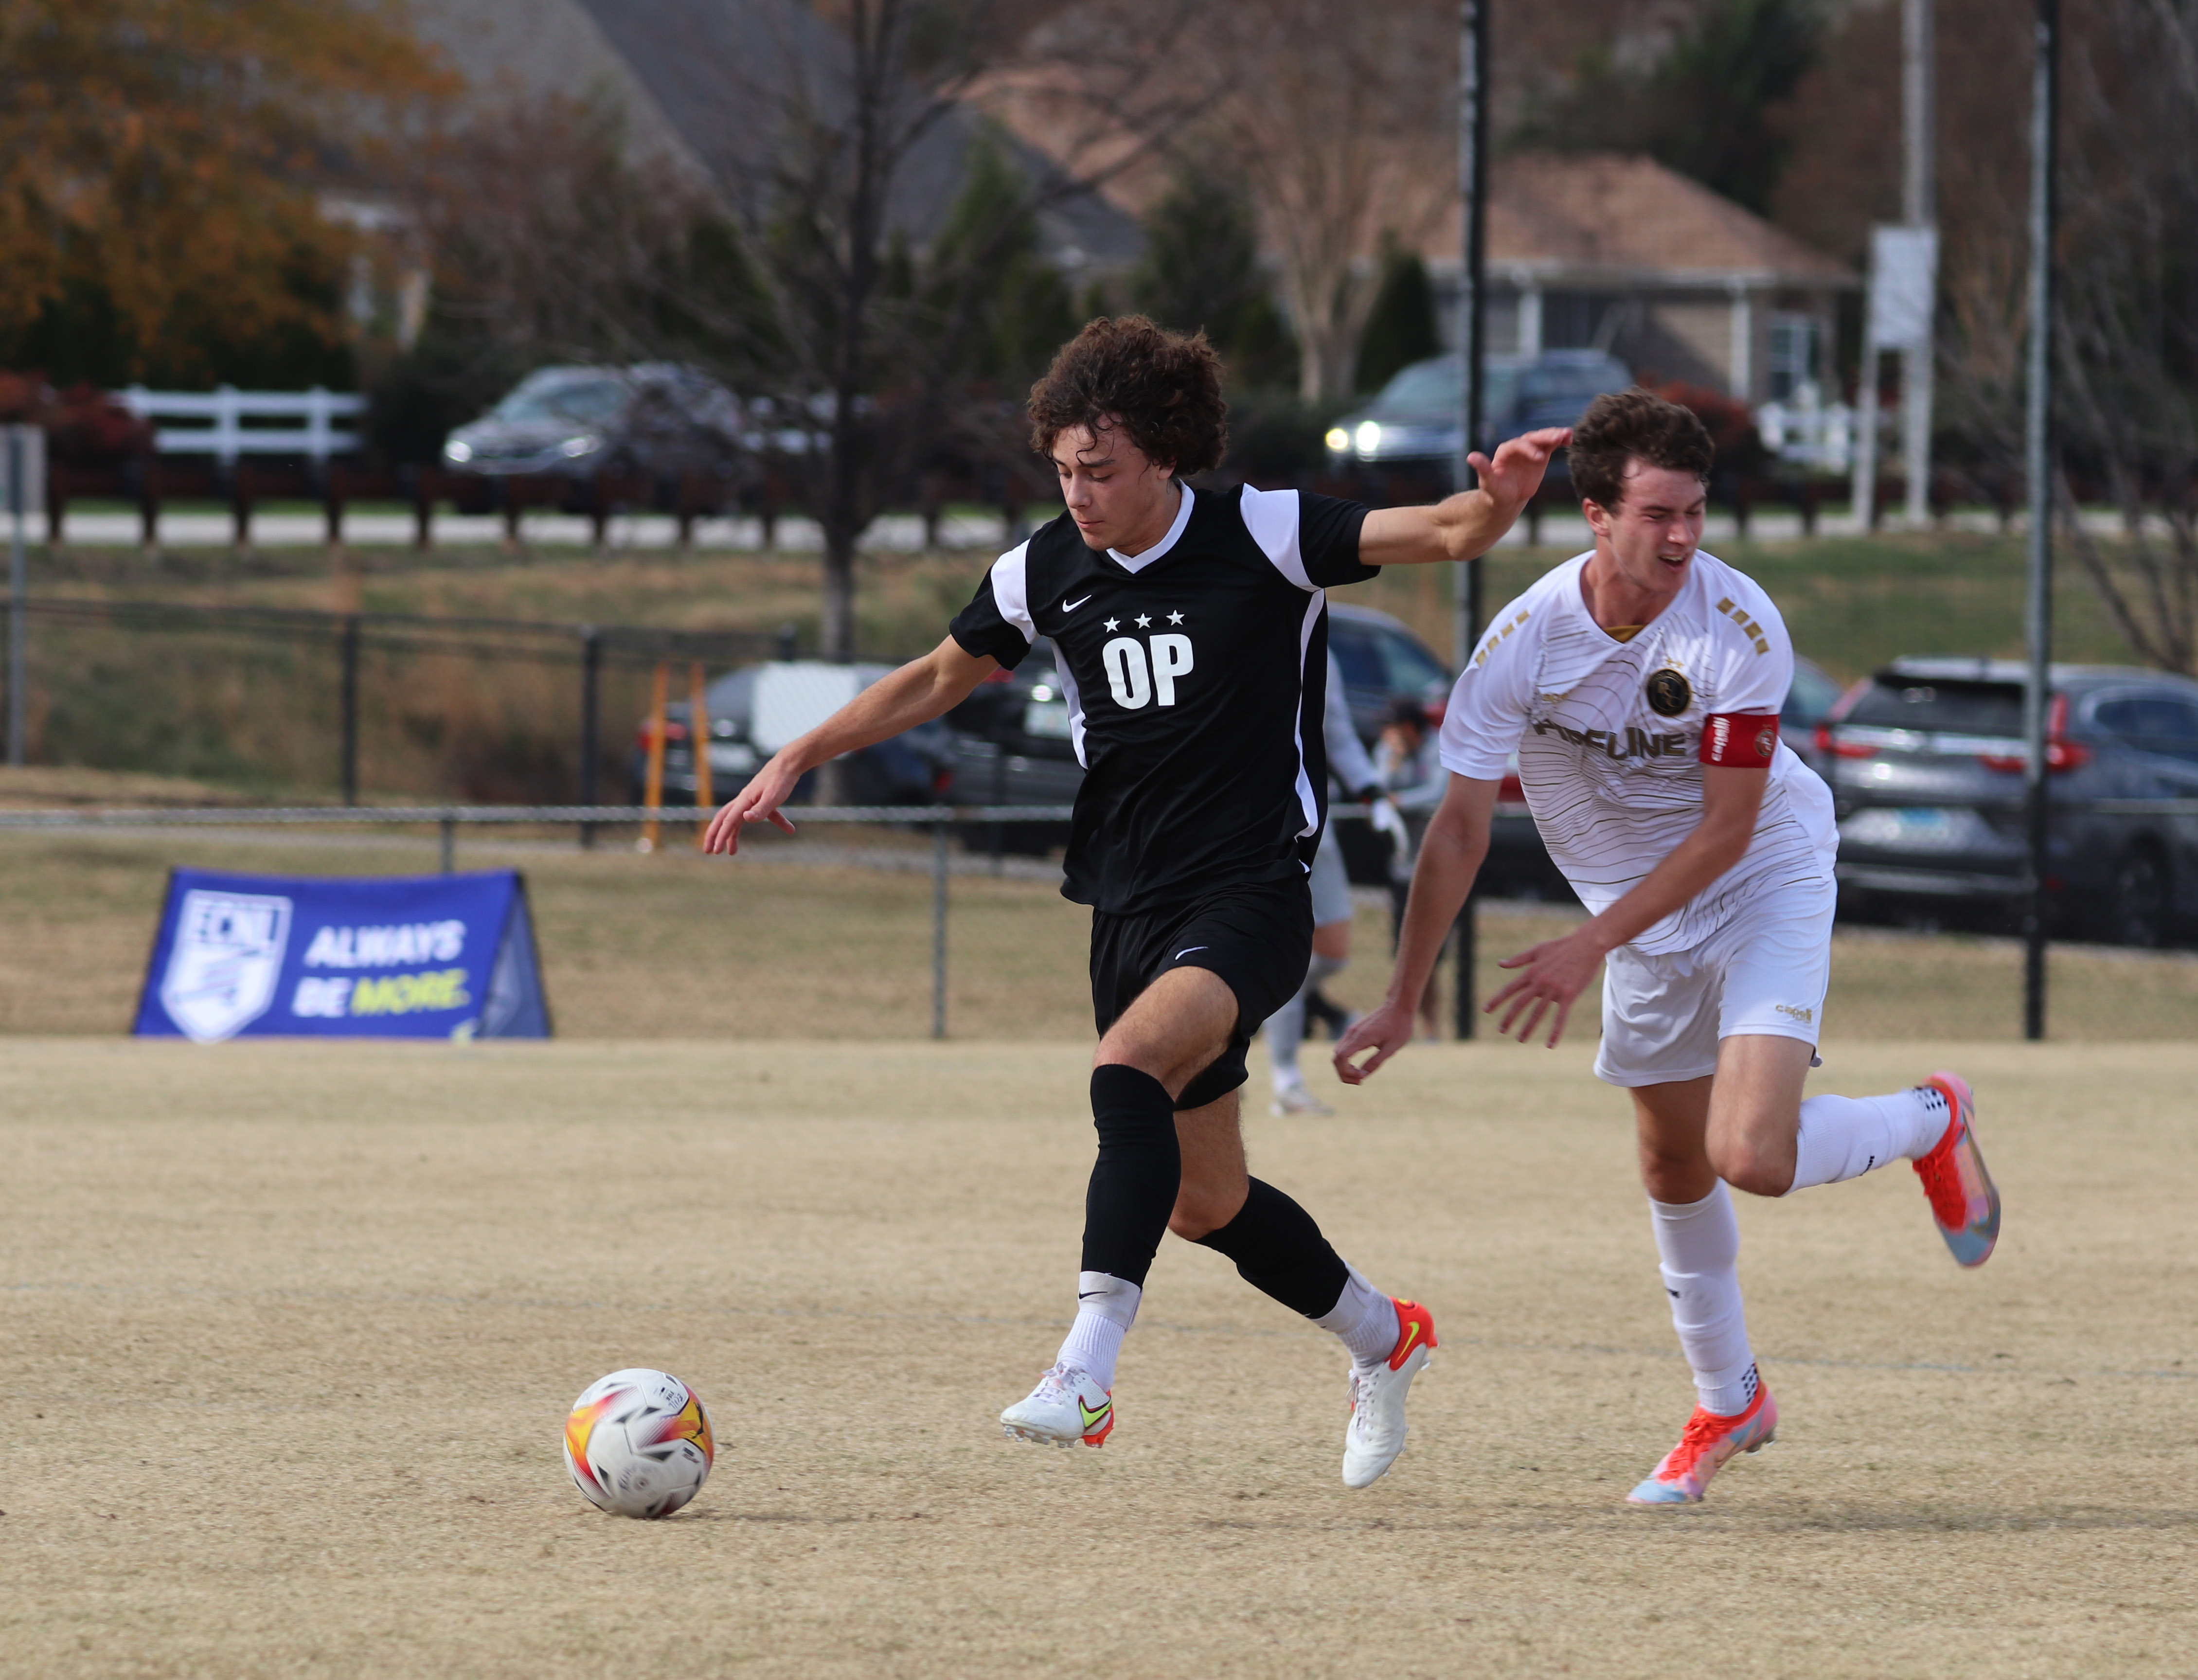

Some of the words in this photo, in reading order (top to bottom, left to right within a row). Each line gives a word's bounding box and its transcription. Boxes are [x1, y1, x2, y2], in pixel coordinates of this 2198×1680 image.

[1102, 634, 1194, 710] OP
[303, 919, 467, 968] ALWAYS
[291, 976, 352, 1018] BE
[350, 967, 472, 1017] MORE
